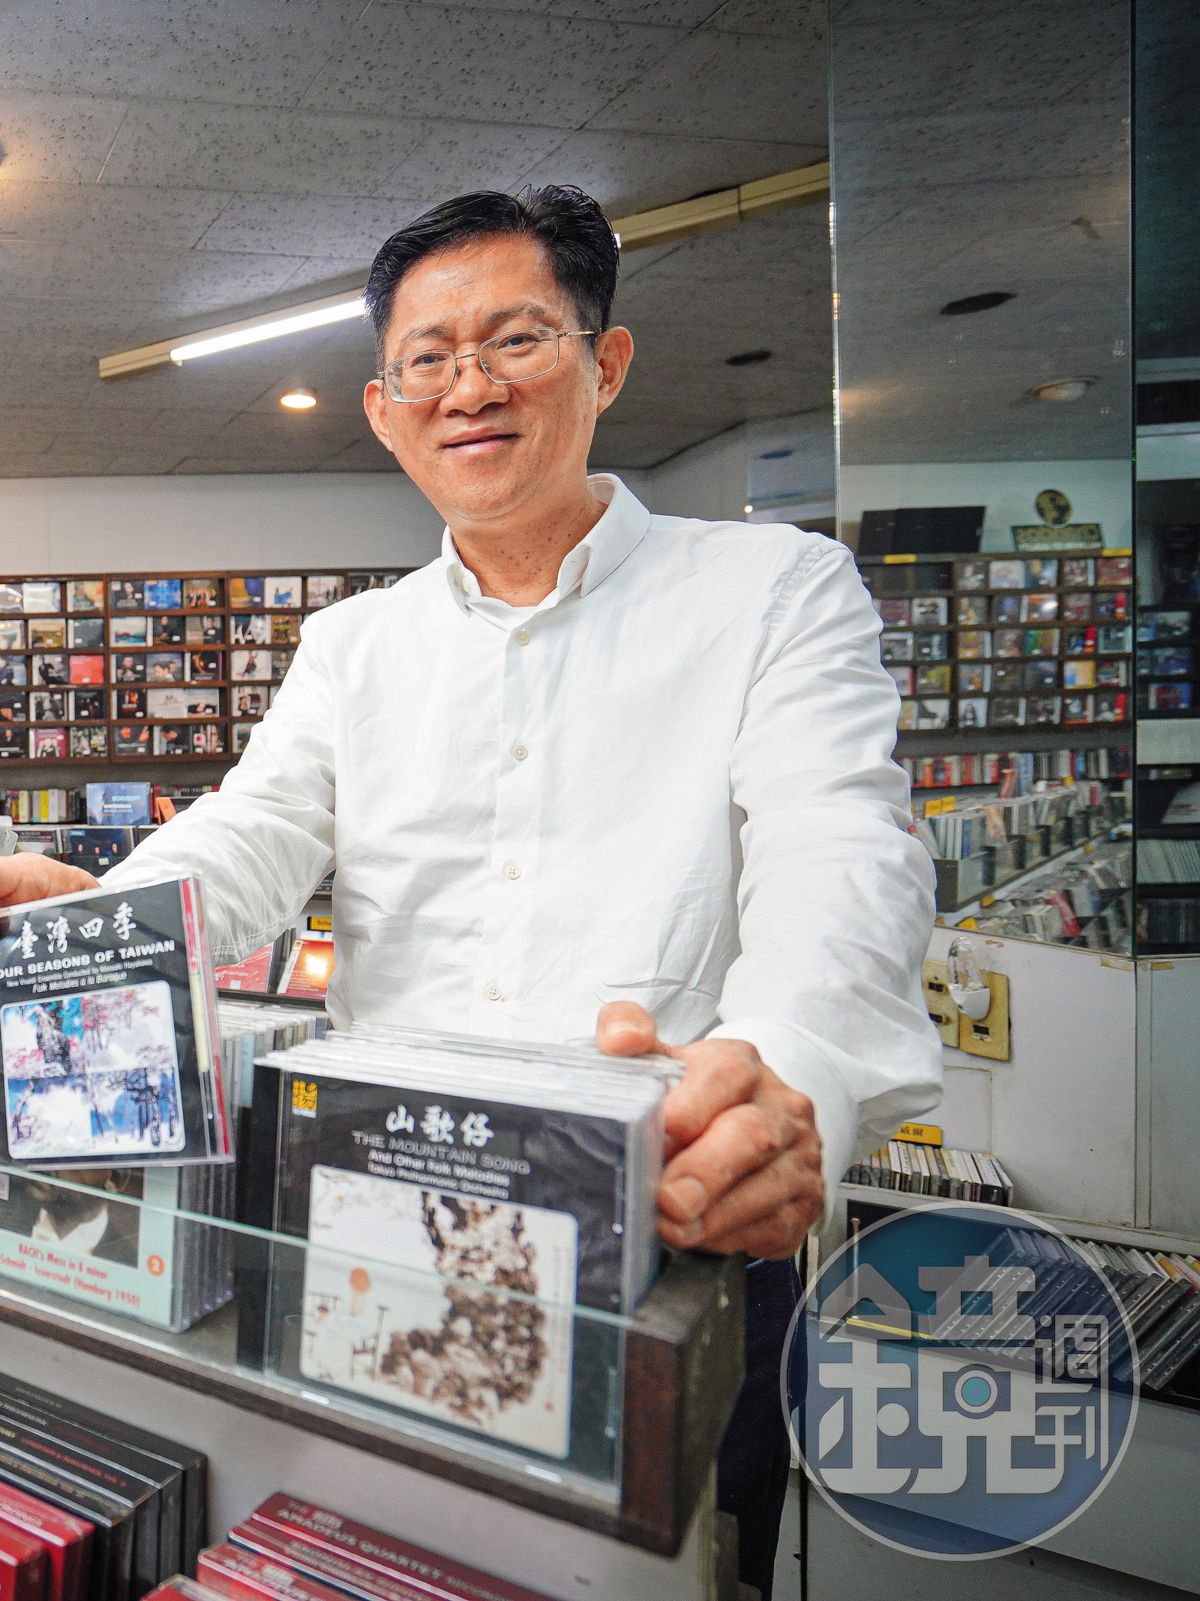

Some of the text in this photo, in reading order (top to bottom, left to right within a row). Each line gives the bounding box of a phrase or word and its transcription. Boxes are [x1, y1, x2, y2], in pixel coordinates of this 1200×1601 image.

[21, 901, 137, 960] 臺灣四季
[27, 954, 90, 974] SEASONS
[94, 949, 115, 964] OF
[117, 939, 175, 960] TAIWAN
[385, 1104, 495, 1147] 山歌仔
[352, 1130, 531, 1175] THE MOUNTAIN SONG
[367, 1149, 392, 1164] And
[392, 1153, 426, 1171] Other
[452, 1164, 510, 1186] Melodies
[47, 1250, 66, 1268] Mass
[85, 1265, 107, 1280] minor
